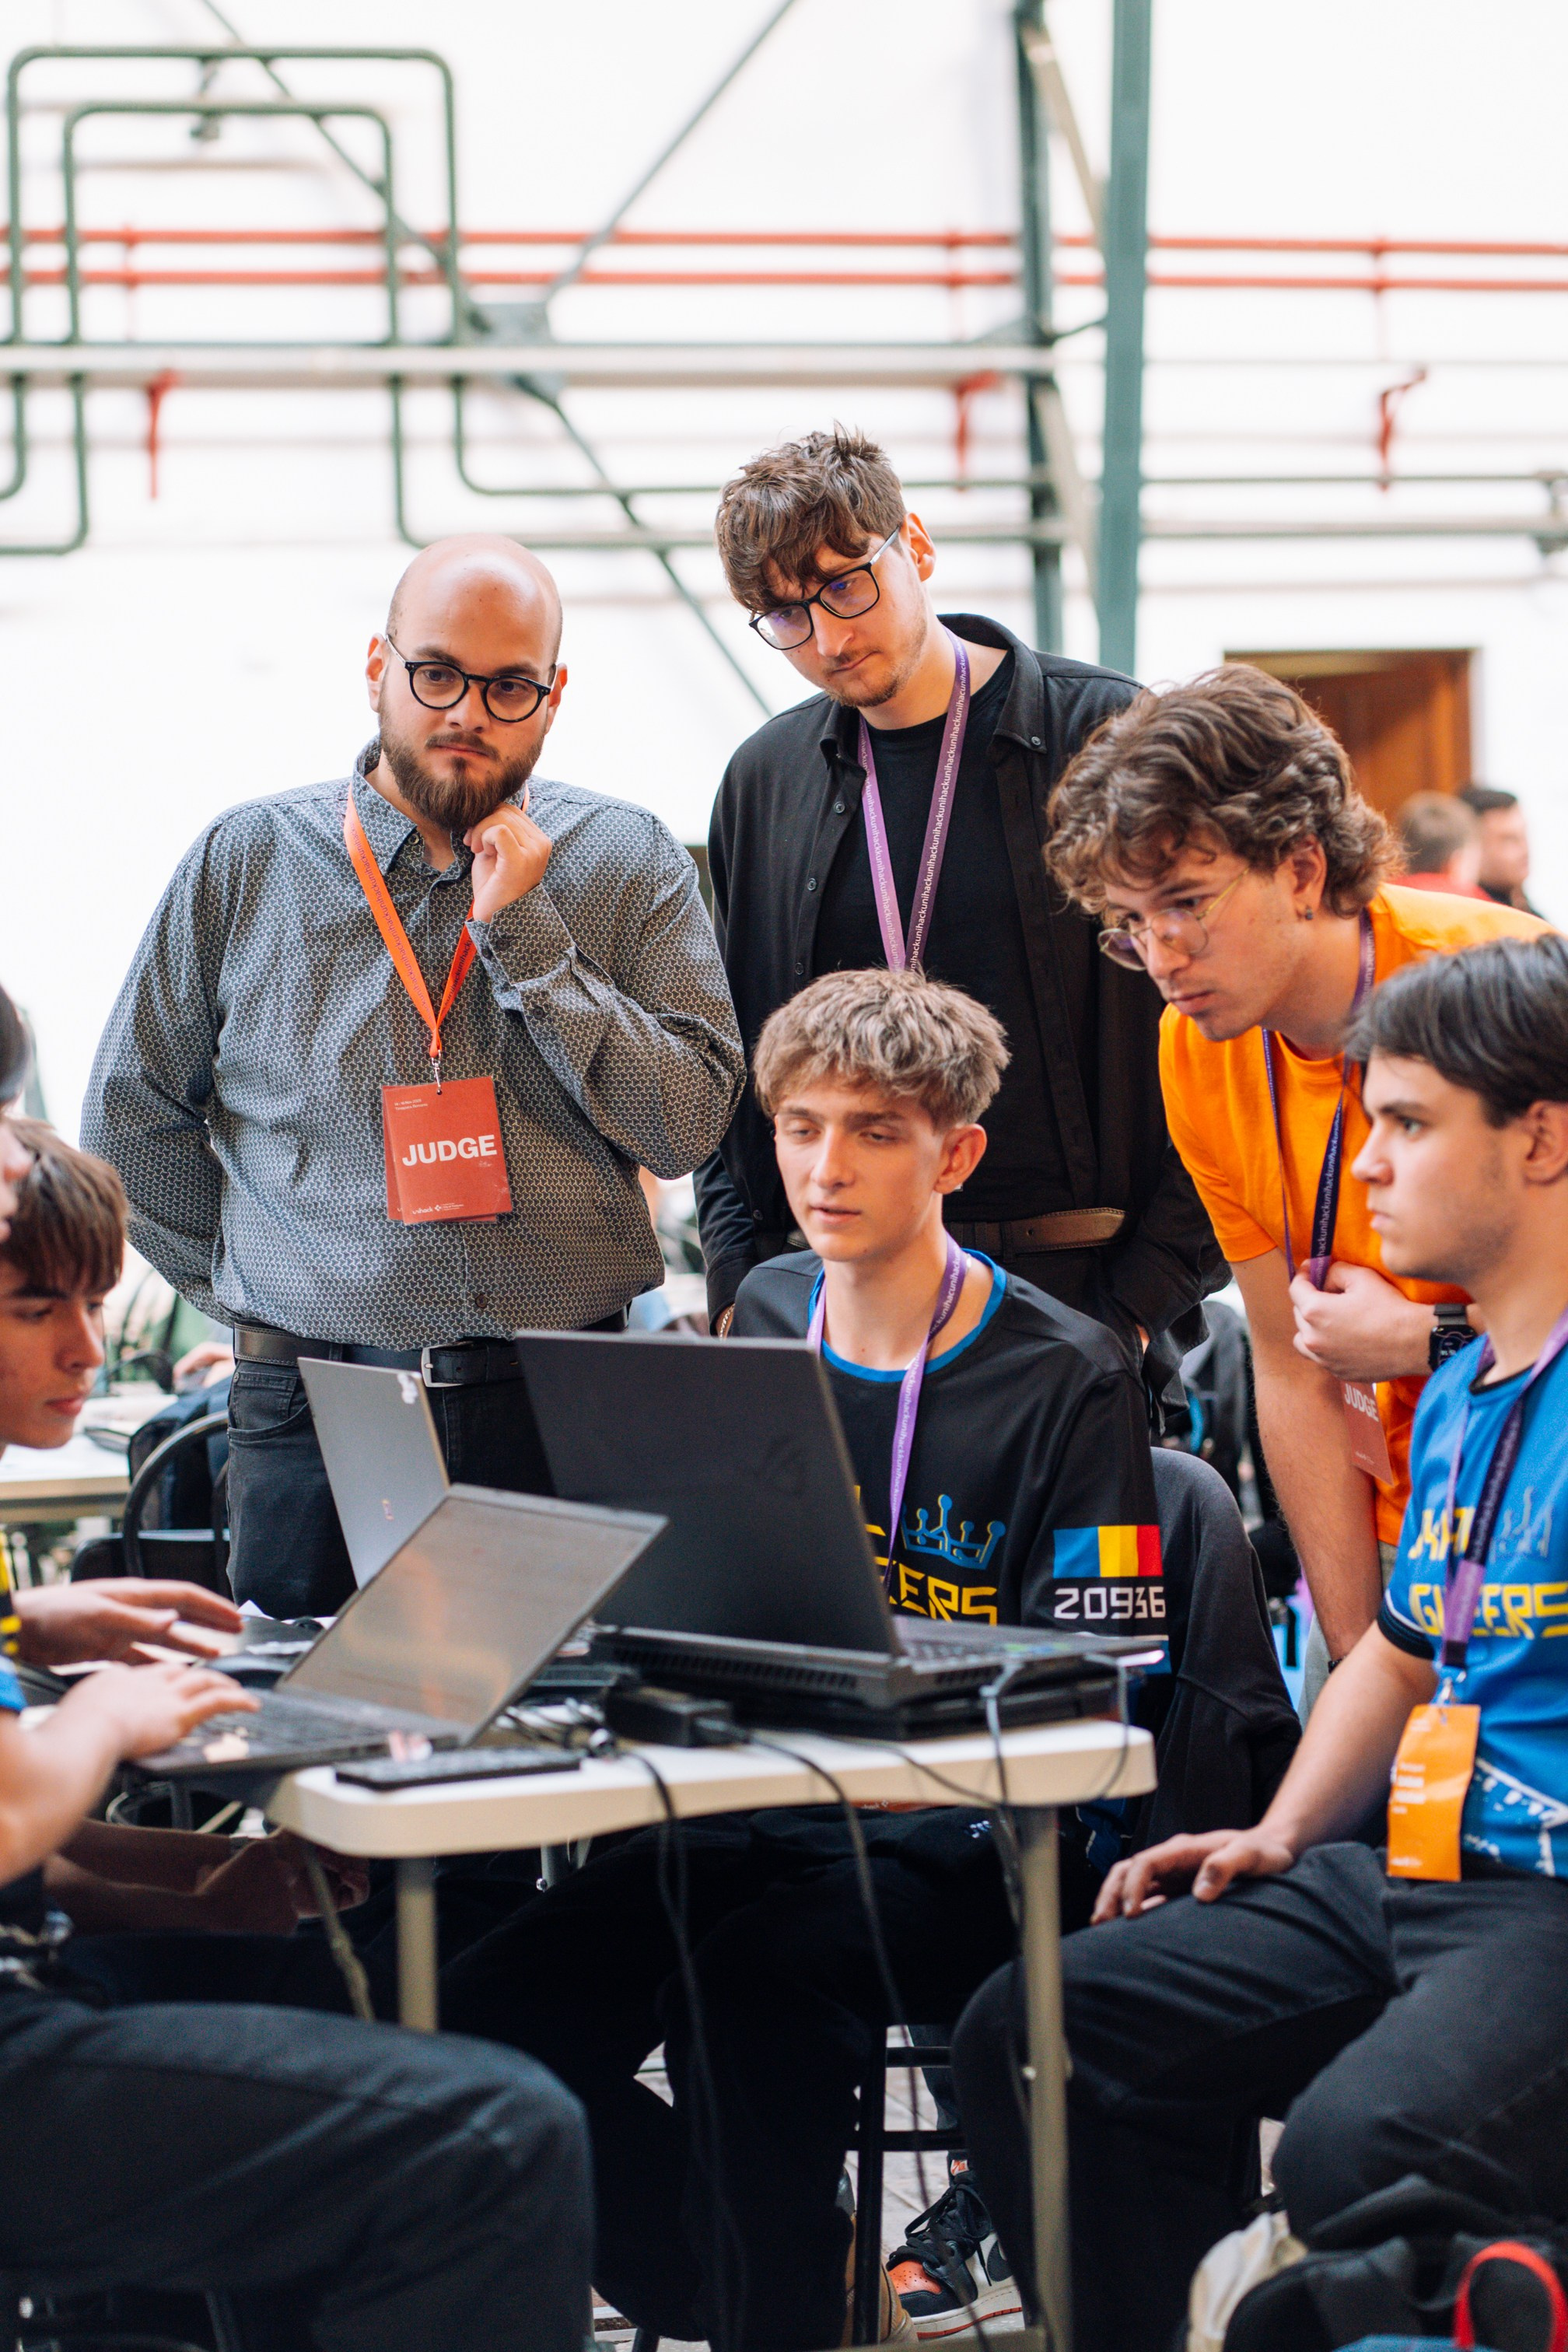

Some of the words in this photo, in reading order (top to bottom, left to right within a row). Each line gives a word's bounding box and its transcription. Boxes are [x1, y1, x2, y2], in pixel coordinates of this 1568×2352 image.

[402, 1134, 497, 1167] JUDGE
[1344, 1383, 1380, 1423] JUDGE
[1054, 1585, 1167, 1620] 20936
